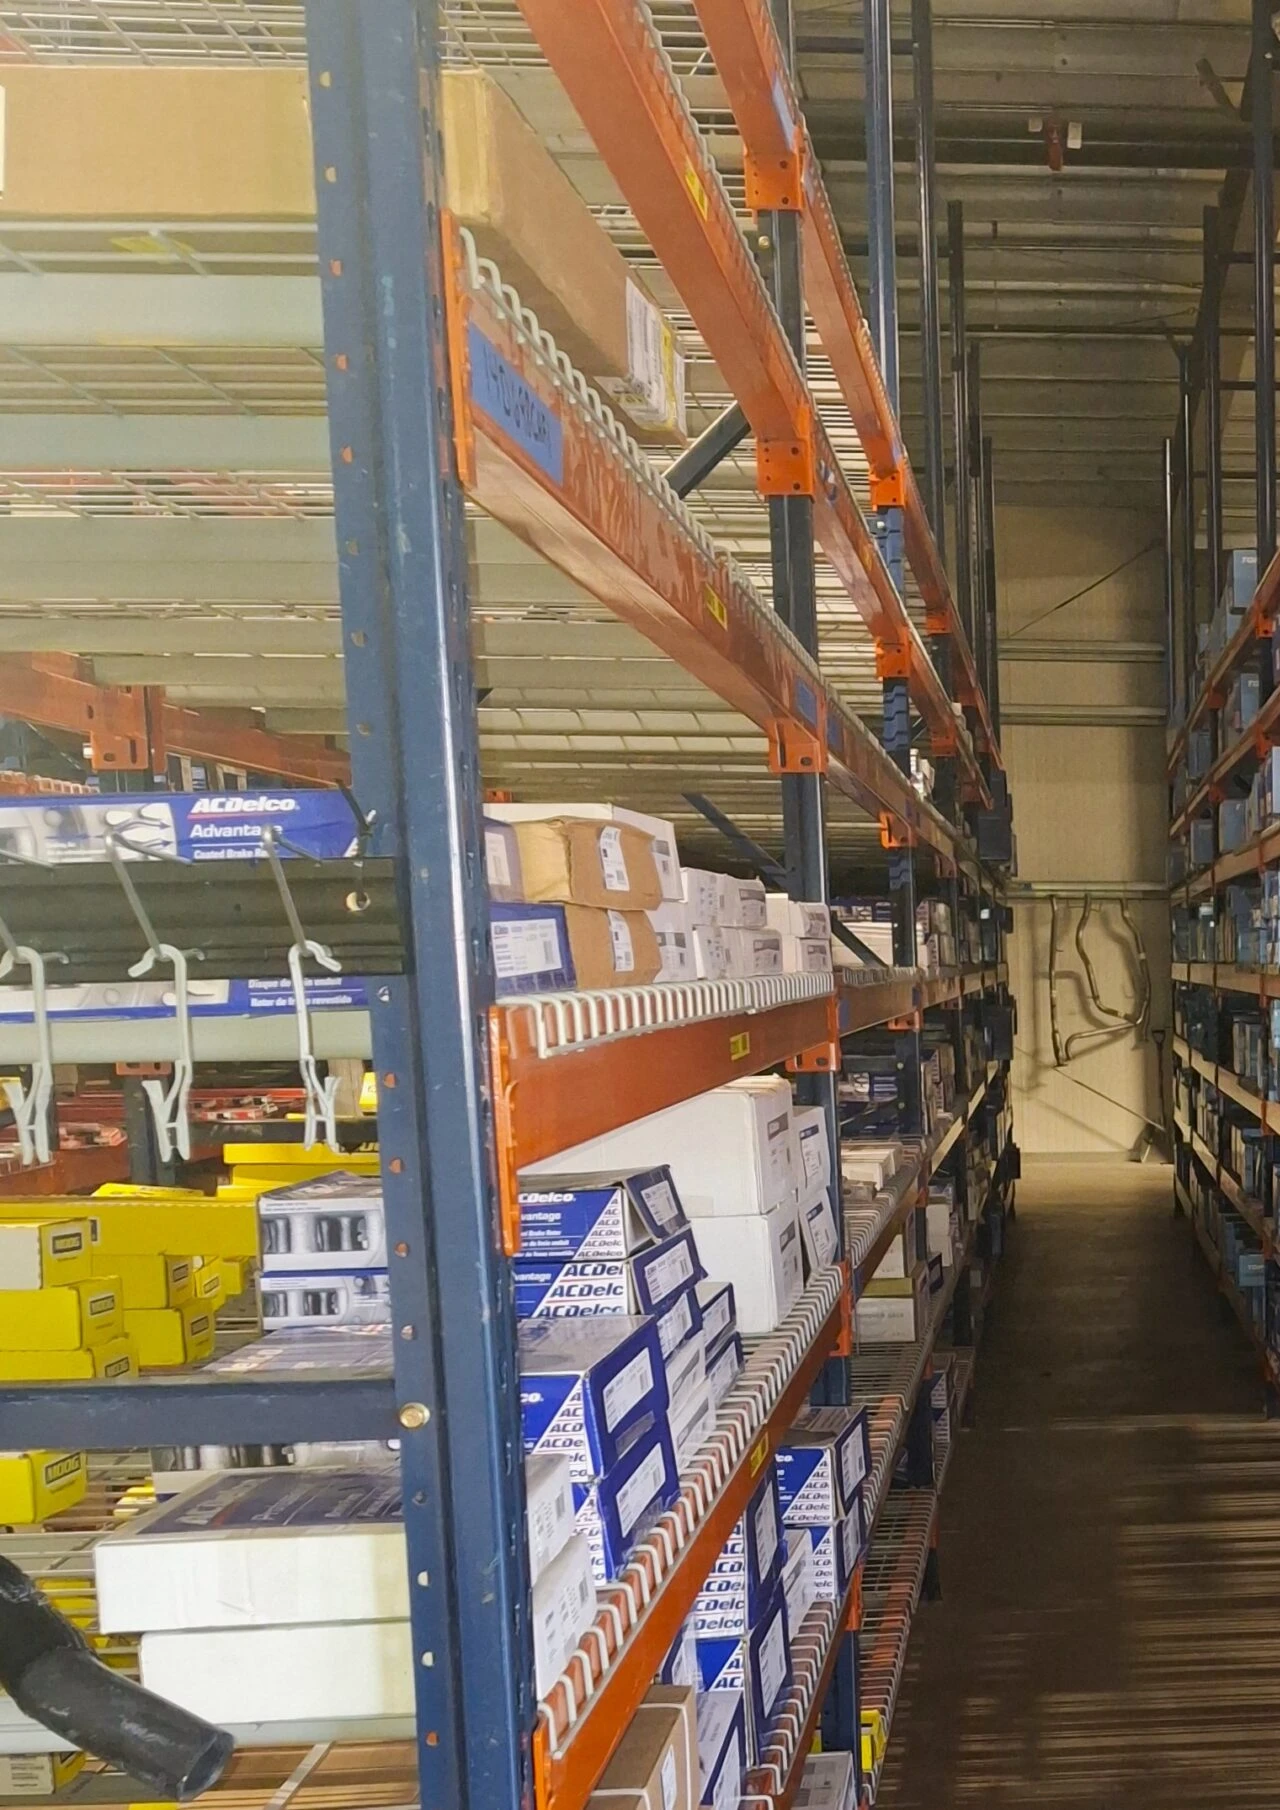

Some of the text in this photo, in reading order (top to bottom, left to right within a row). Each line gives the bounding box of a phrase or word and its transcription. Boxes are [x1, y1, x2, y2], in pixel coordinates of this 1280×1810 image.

[190, 796, 297, 813] ACDelco
[190, 824, 283, 838] Advantae
[518, 1192, 574, 1203] CDelco
[521, 1213, 562, 1222] vantage
[577, 1250, 624, 1258] ACDelco
[515, 1273, 552, 1283] vantage
[560, 1408, 583, 1418] AC
[551, 1423, 584, 1433] ACD
[540, 1438, 585, 1448] ACDe
[713, 1561, 743, 1574] CD
[703, 1581, 744, 1592] CDel
[696, 1600, 744, 1611] CDelc
[695, 1618, 744, 1630] Delco
